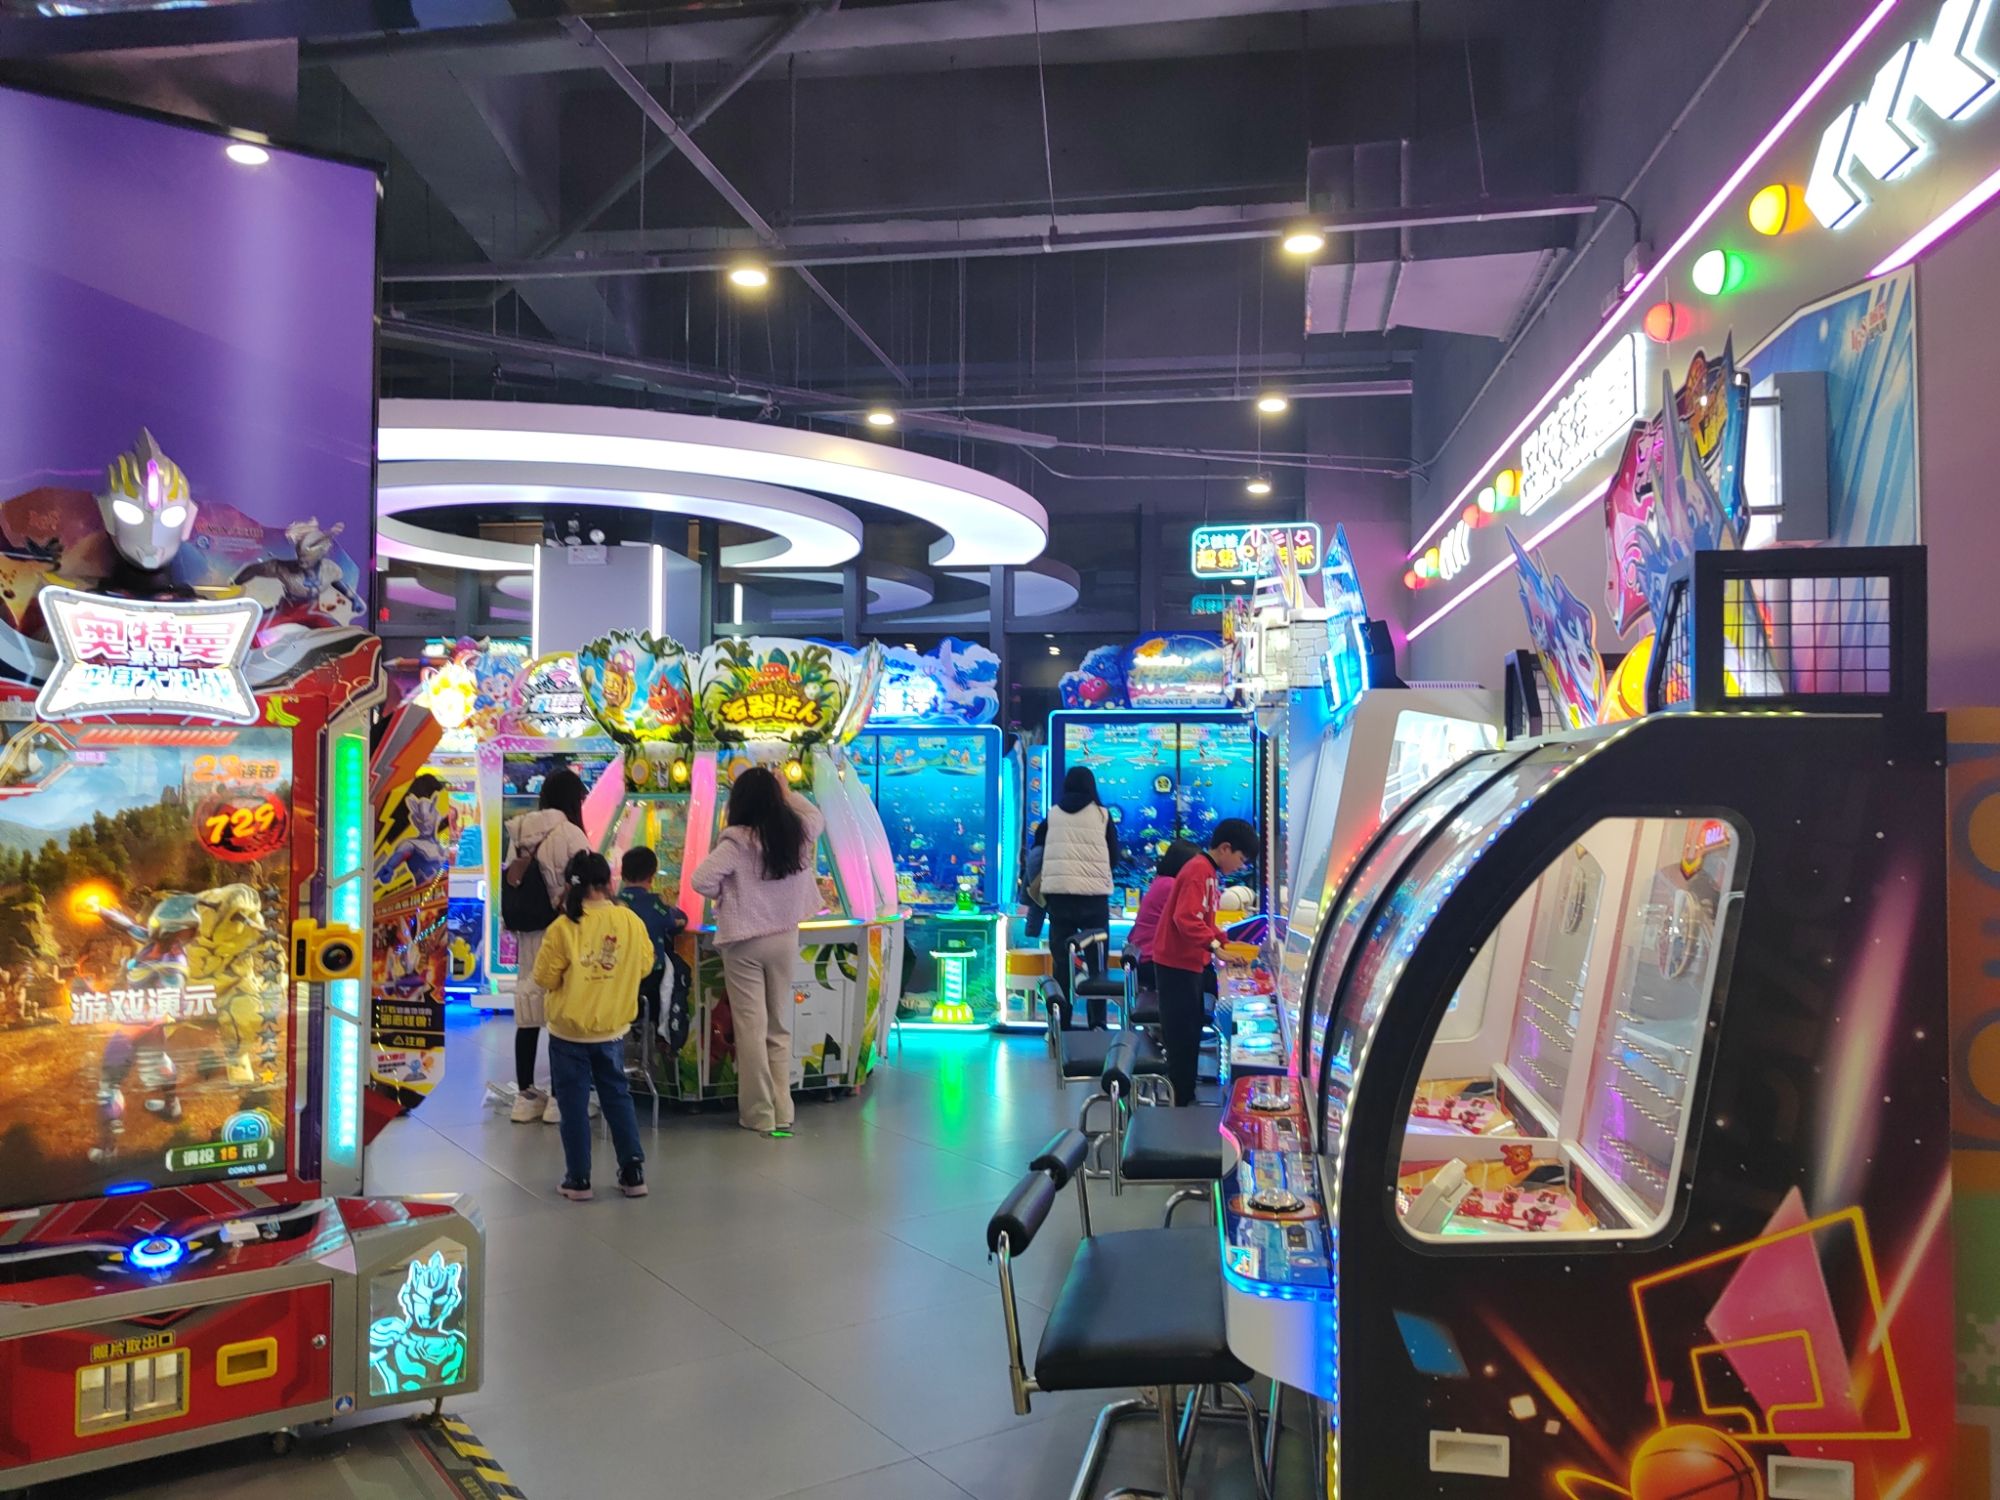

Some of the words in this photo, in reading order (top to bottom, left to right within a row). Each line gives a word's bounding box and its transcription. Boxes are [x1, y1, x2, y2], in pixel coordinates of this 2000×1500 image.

[70, 611, 236, 661] 奥特曼
[721, 692, 820, 725] 石器达人
[1136, 698, 1192, 706] ENCHANTED
[206, 803, 274, 844] 729
[70, 985, 217, 1025] 游戏演示
[93, 1332, 174, 1361] 照片取出口
